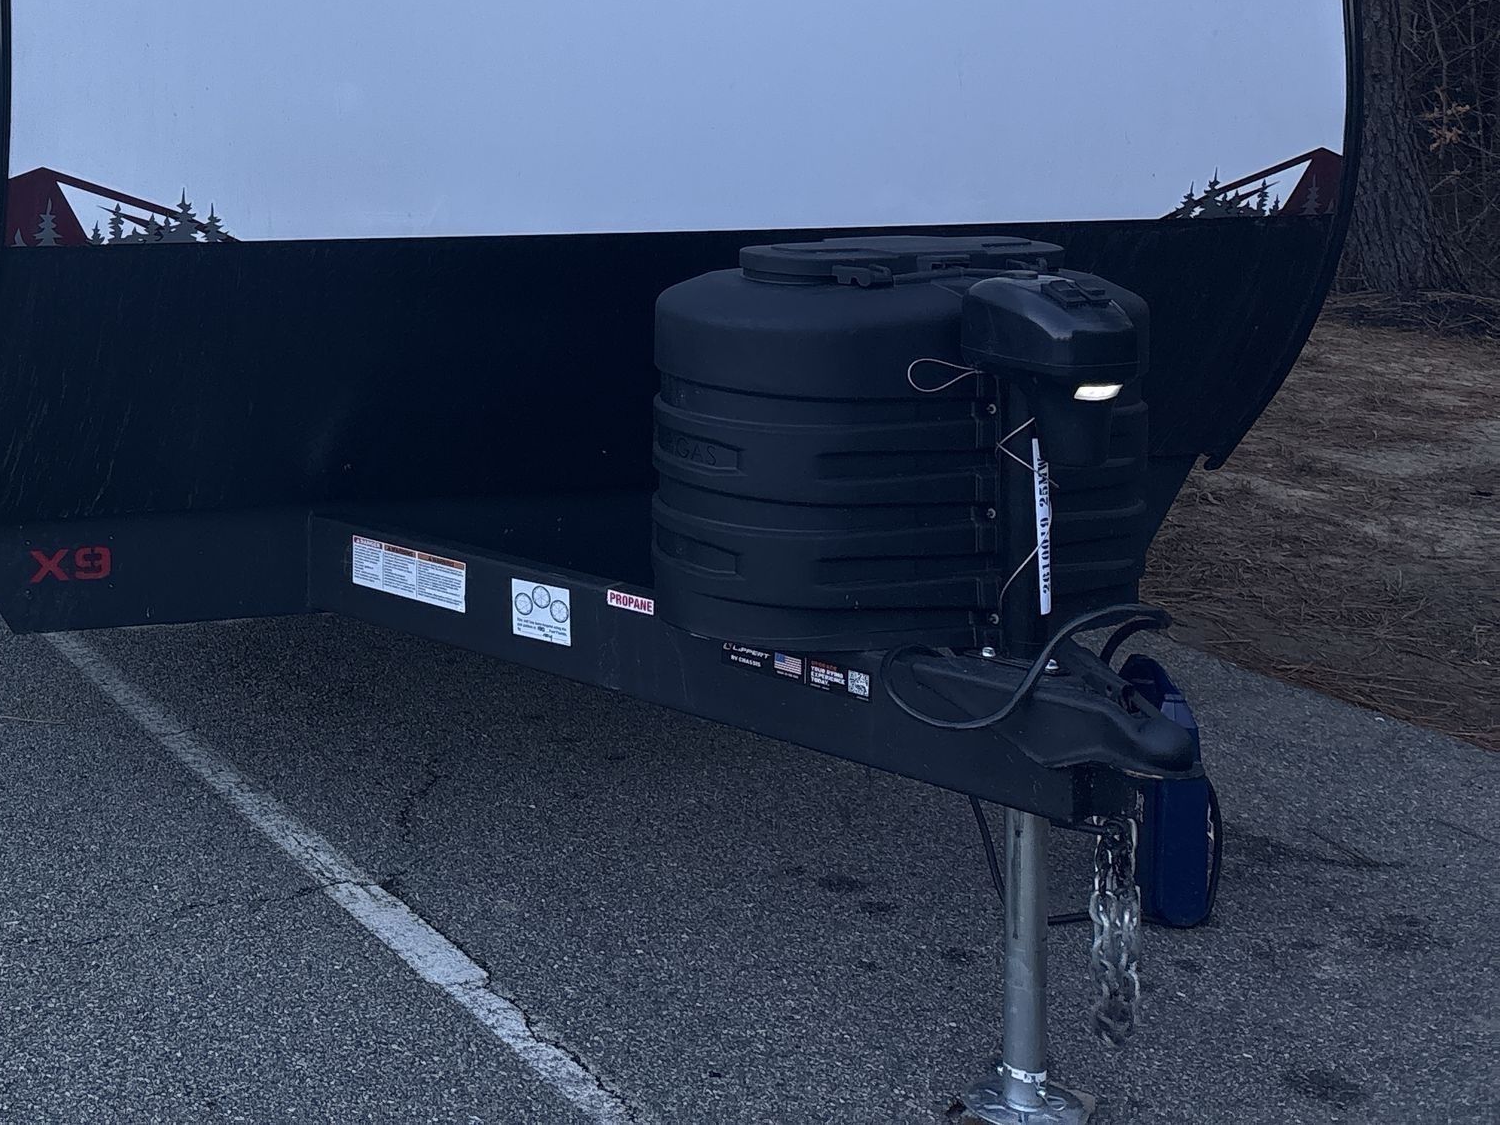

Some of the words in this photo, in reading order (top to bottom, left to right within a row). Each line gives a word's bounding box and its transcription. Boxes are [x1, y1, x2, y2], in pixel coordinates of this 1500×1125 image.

[676, 437, 717, 466] GAS
[28, 545, 113, 584] X9
[609, 591, 653, 613] PROPANE
[732, 645, 771, 659] LIPPERT
